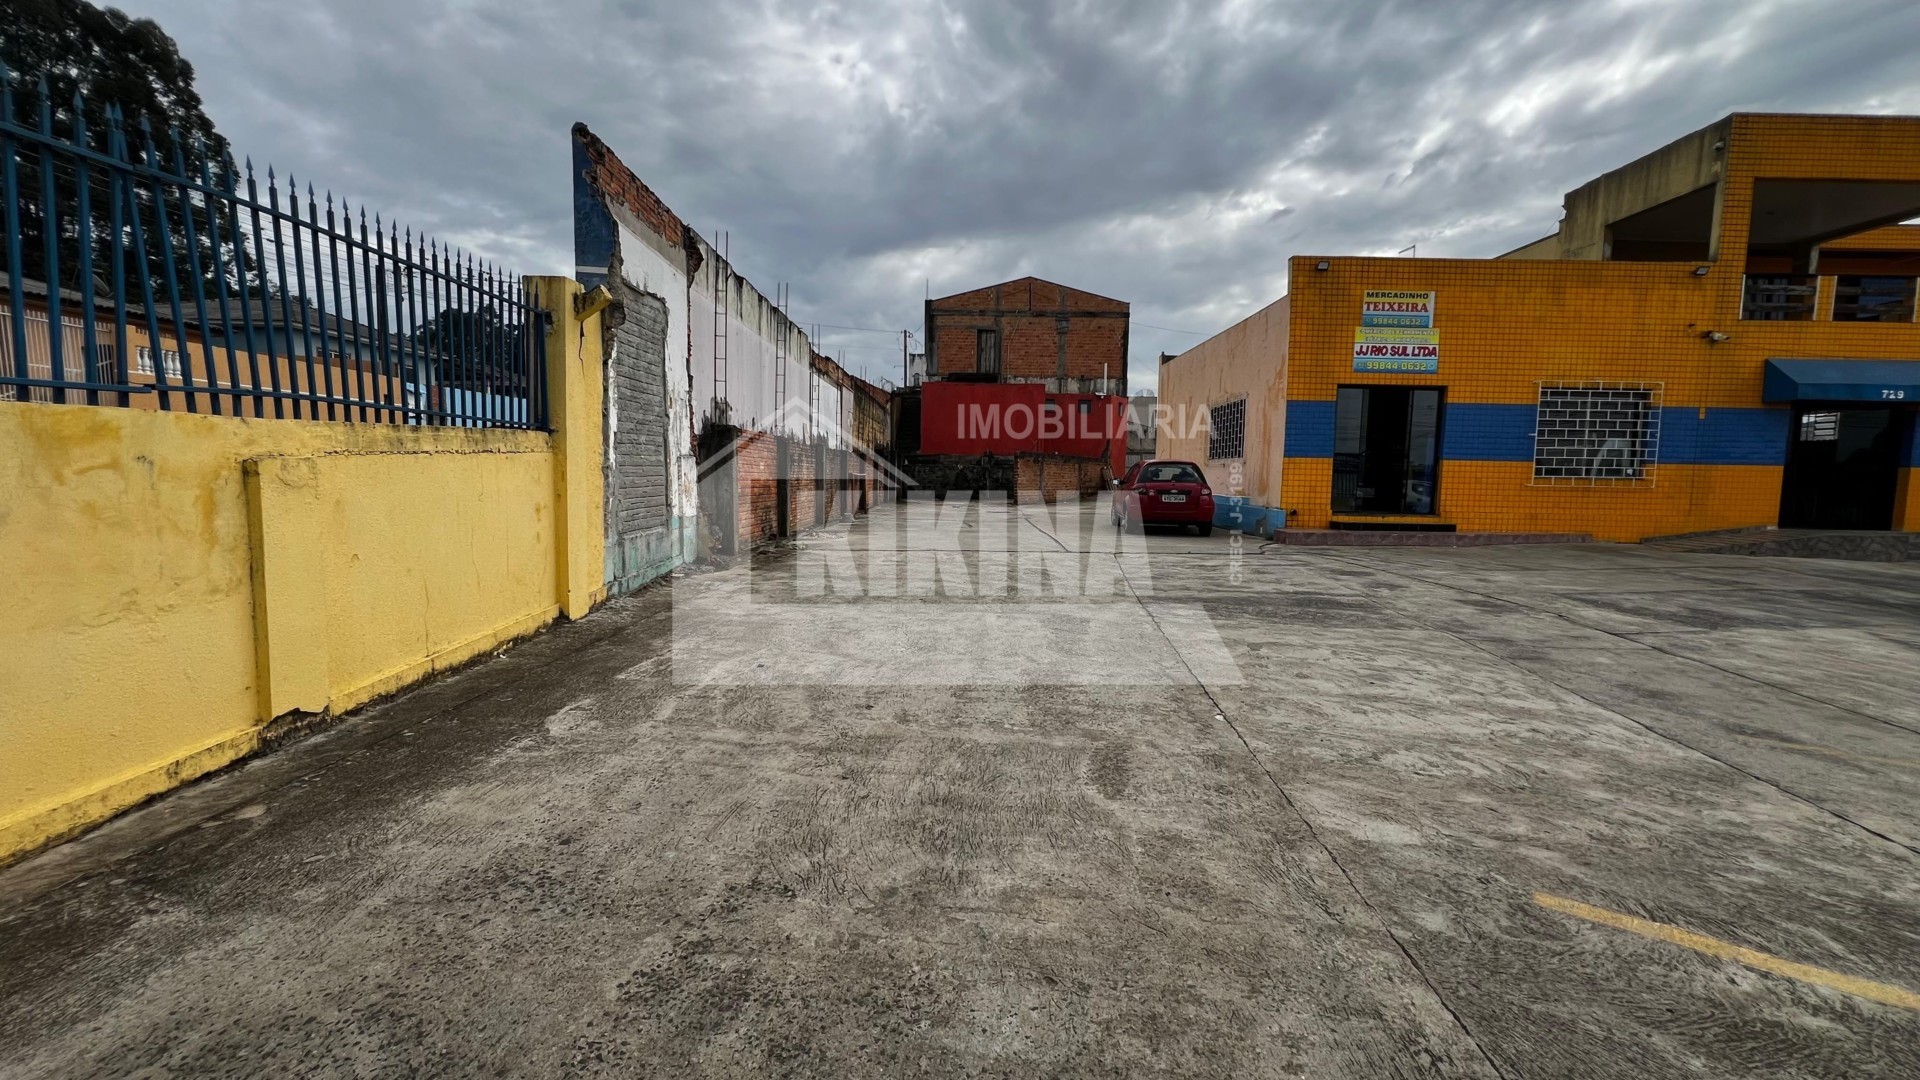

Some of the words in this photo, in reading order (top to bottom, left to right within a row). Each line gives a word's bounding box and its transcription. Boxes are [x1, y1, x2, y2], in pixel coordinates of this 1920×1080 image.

[1365, 302, 1428, 312] TEIXEIRA
[1370, 345, 1389, 357] RIO
[1389, 346, 1409, 356] SUL
[1411, 346, 1437, 357] LTDA
[1881, 389, 1905, 399] 729
